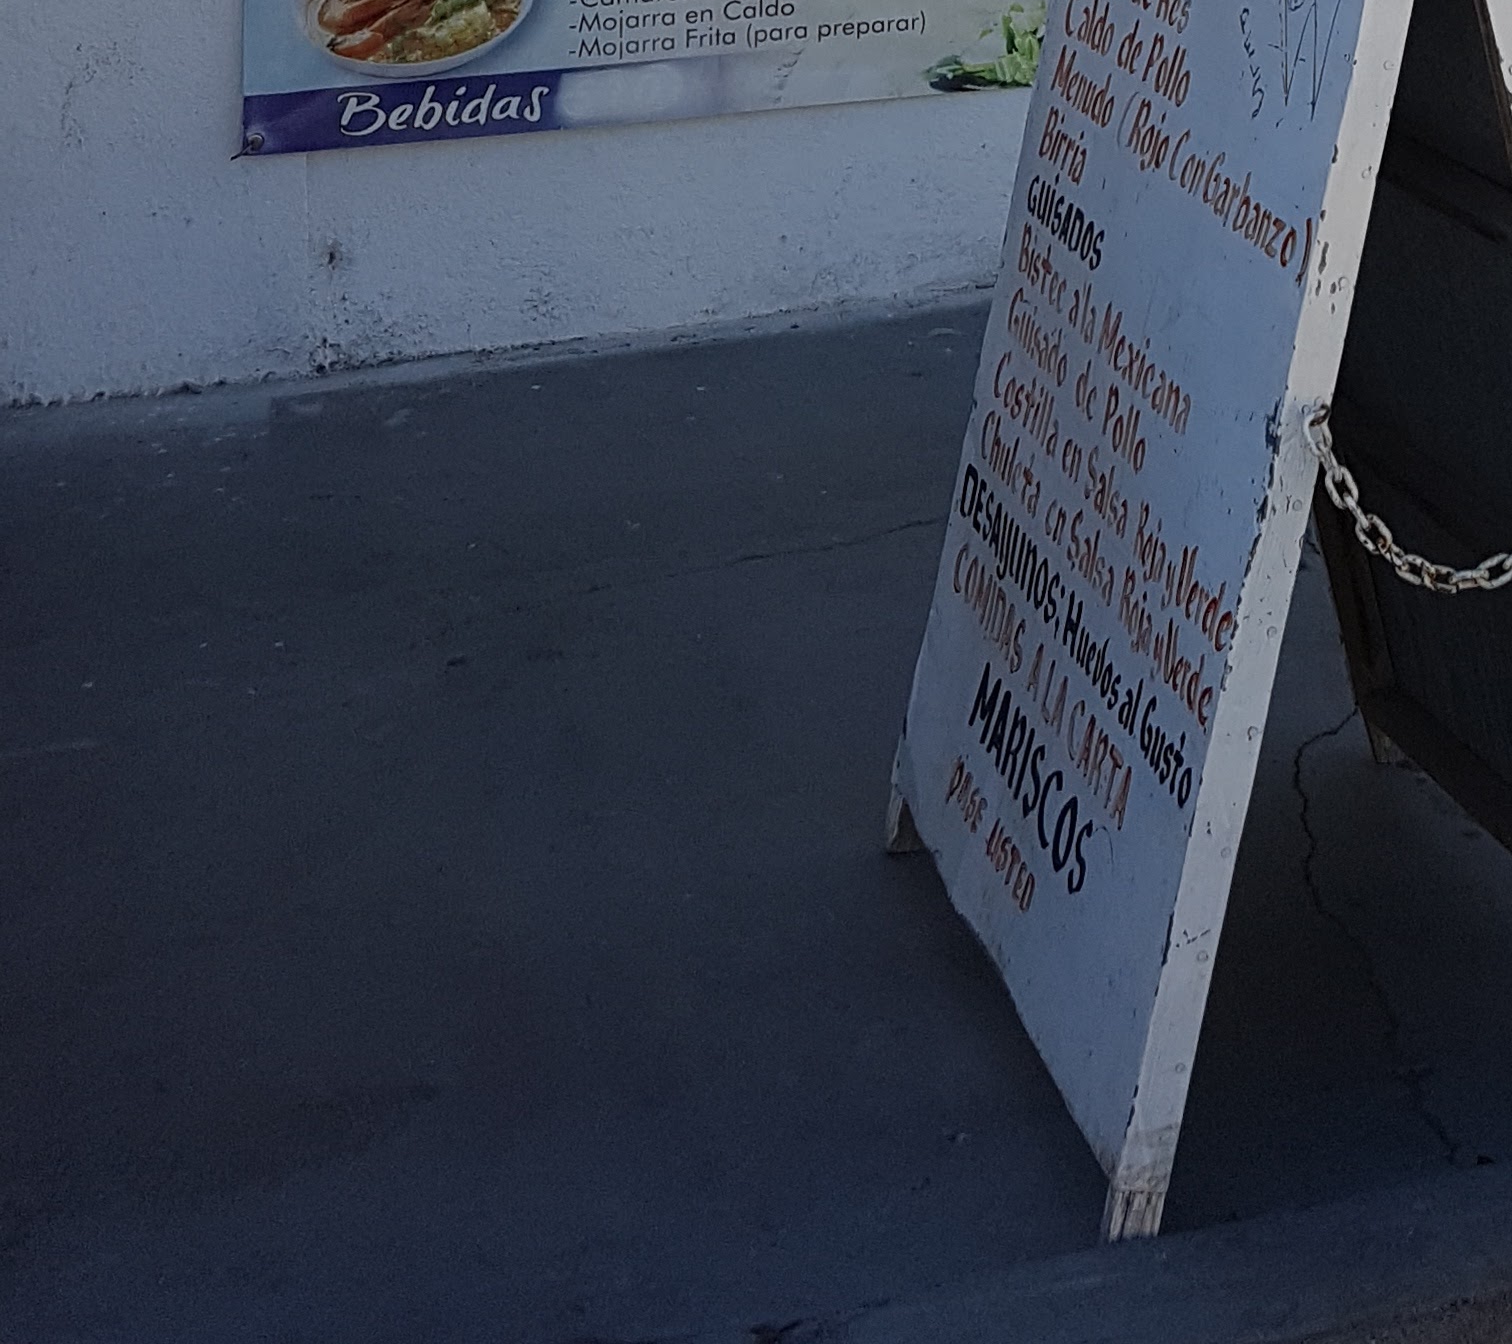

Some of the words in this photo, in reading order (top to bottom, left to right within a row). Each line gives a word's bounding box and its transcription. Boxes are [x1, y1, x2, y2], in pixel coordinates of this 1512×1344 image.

[568, 35, 675, 60] -Mojarra
[686, 27, 736, 49] Frita
[746, 23, 808, 48] (para
[818, 11, 926, 41] preparar)
[569, 9, 676, 38] -Mojarra
[685, 8, 713, 23] en
[1117, 19, 1144, 75] de
[1142, 31, 1191, 108] Pollo
[337, 83, 550, 136] Bebidas
[1050, 44, 1115, 128] Menudo
[1038, 105, 1088, 186] Birria
[1027, 174, 1105, 271] GUISADOS
[1019, 221, 1066, 314] Bistec
[1099, 302, 1192, 435] Mexicana
[994, 351, 1060, 458] Costilla
[1062, 438, 1082, 483] en
[1007, 287, 1068, 387] Guisado
[1076, 359, 1098, 422] de
[1103, 383, 1146, 473] Pollo
[953, 543, 1026, 673] COMIDAS
[1067, 700, 1132, 830] CARTA
[968, 662, 1093, 894] MARISCOS
